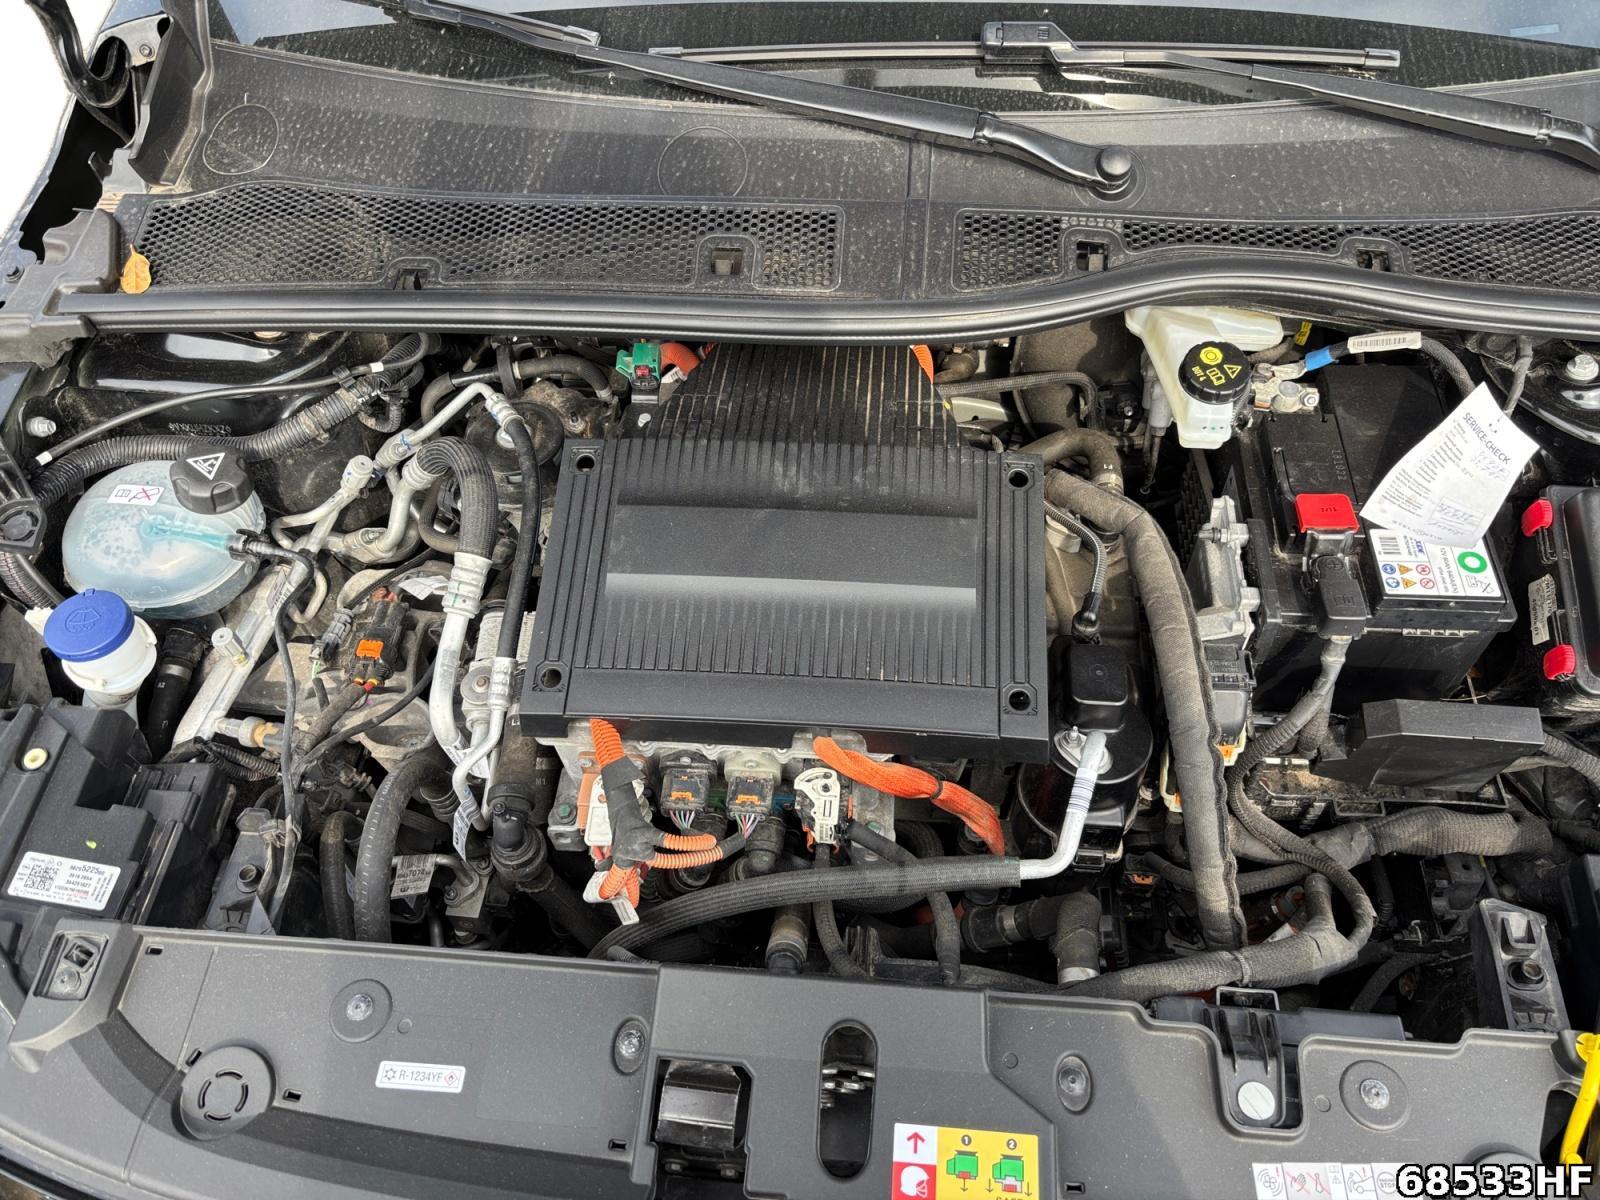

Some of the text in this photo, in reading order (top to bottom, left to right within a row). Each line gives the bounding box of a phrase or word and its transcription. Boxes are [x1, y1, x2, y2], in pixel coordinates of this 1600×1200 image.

[1191, 365, 1204, 377] DOT
[1462, 412, 1511, 465] SERVICE-CHECK
[399, 1069, 444, 1083] R-1234YF
